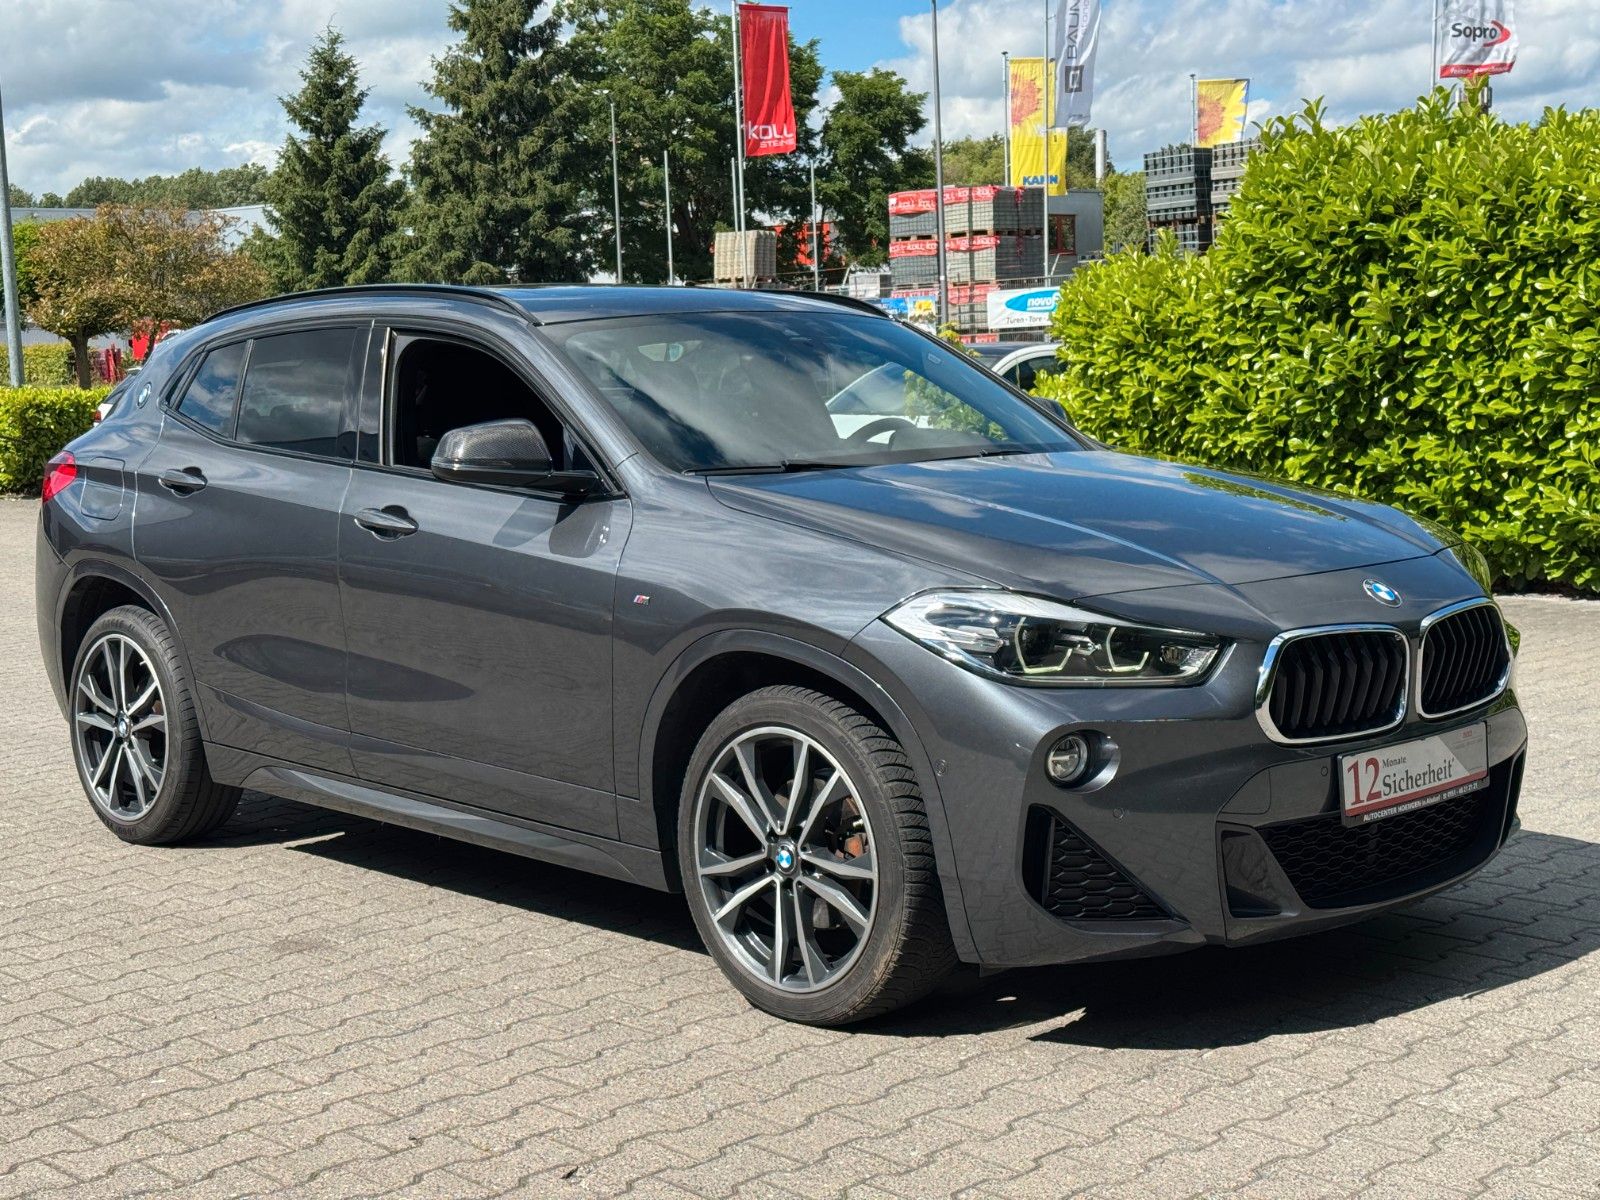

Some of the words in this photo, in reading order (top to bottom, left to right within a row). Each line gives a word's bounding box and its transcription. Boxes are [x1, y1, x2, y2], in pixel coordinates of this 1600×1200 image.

[1451, 22, 1498, 42] Sopro
[748, 120, 794, 140] KOLL
[1382, 756, 1407, 769] Monate
[1347, 757, 1382, 806] 12
[1382, 758, 1453, 797] Sicherheit
